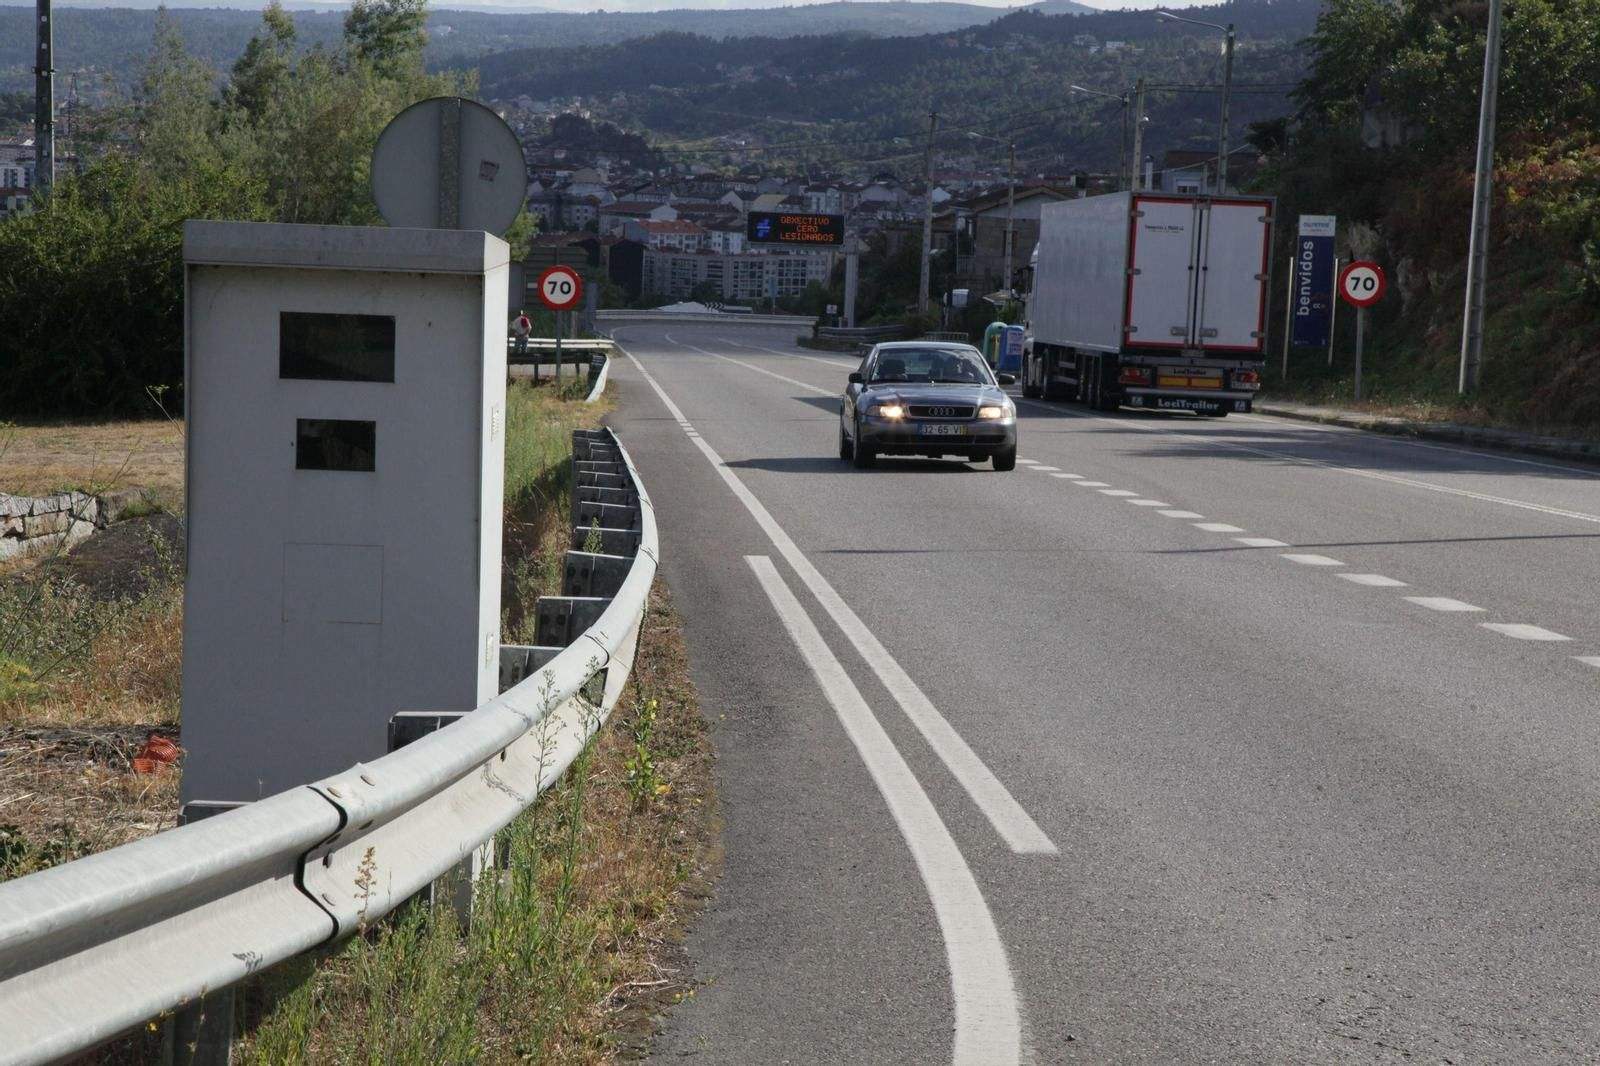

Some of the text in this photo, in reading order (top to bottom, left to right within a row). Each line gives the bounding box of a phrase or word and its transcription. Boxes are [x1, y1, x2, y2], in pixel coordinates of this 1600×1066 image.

[780, 216, 829, 225] OBXECTIVO
[796, 225, 819, 233] CERO
[780, 232, 834, 241] LESIONADOS
[1296, 241, 1314, 316] benvidos
[1350, 276, 1376, 292] 70
[547, 280, 572, 295] 70
